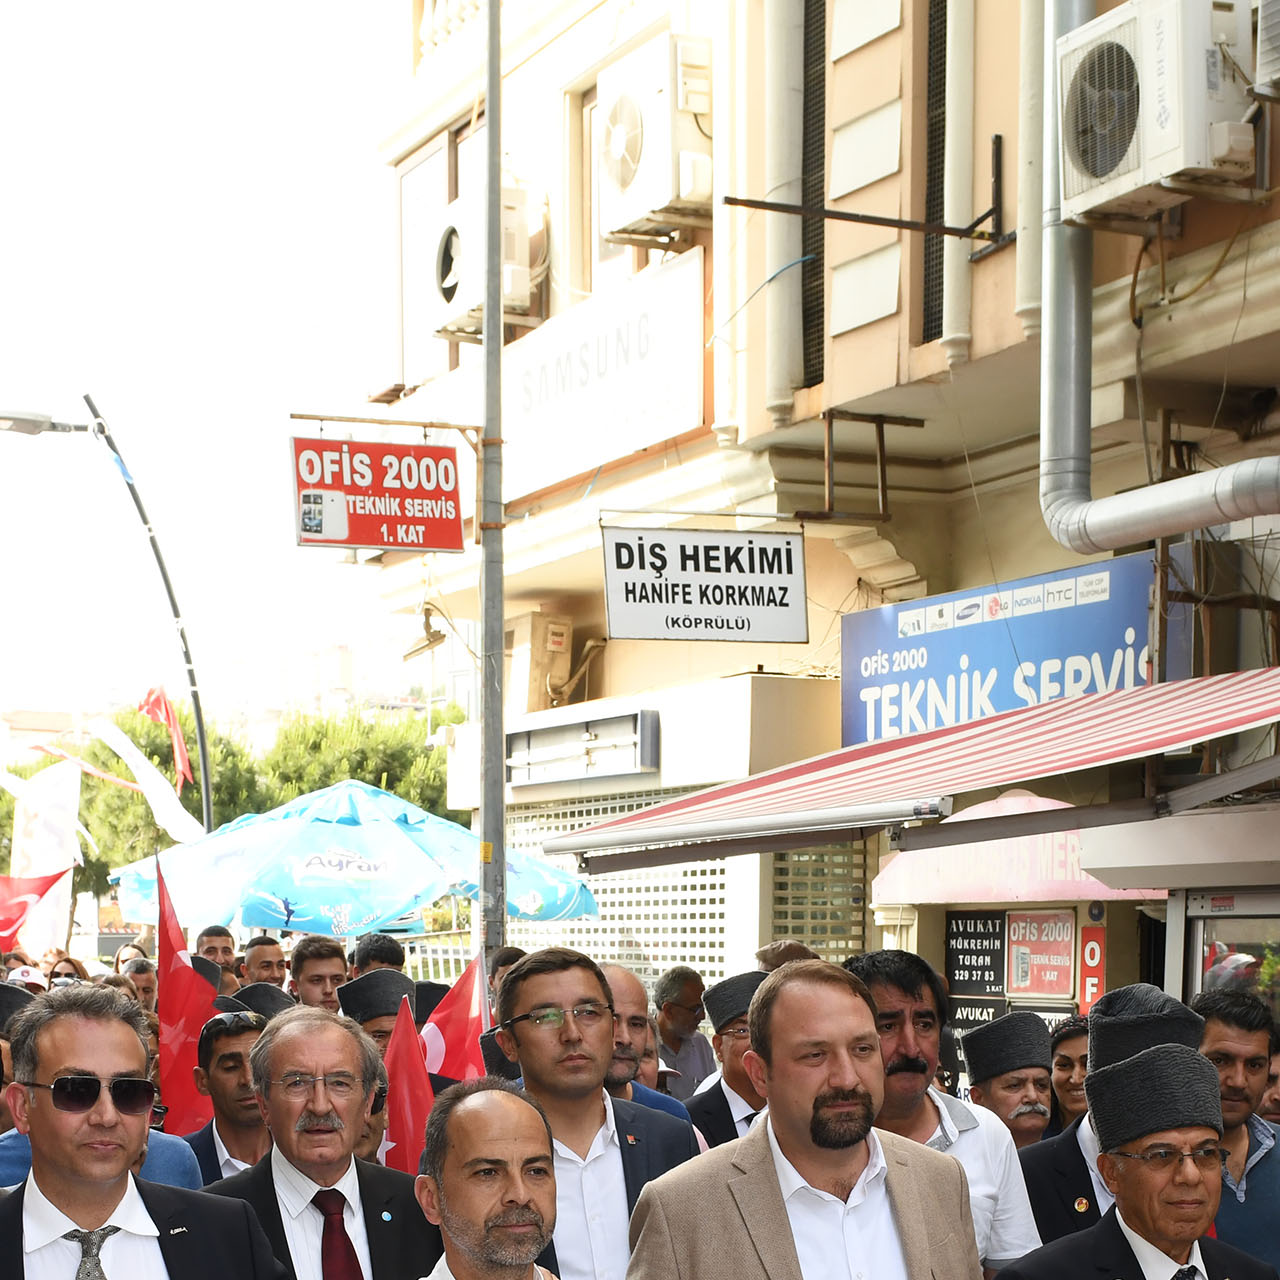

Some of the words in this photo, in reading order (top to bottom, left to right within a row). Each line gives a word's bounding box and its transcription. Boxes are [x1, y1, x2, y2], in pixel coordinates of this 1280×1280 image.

[522, 311, 651, 413] SAMSUNG
[298, 444, 373, 487] OFİS
[381, 454, 456, 492] 2000
[345, 492, 402, 517] TEKNİK
[404, 495, 457, 520] SERVİS
[380, 523, 394, 543] 1.
[396, 524, 426, 544] KAT
[614, 536, 668, 579] DİŞ
[679, 540, 794, 575] HEKİMİ
[624, 577, 693, 605] HANİFE
[698, 584, 790, 608] KORKMAZ
[1014, 594, 1041, 609] NOKIA
[665, 614, 751, 632] (KÖPRÜLÜ)
[860, 648, 889, 678] OFİS
[892, 647, 928, 671] 2000
[860, 654, 998, 742] TEKNİK
[949, 919, 1001, 933] AVUKAT
[1009, 919, 1038, 942] OFİS
[1041, 922, 1071, 942] 2000
[949, 936, 1001, 950] MÜKREMİN
[958, 954, 991, 967] TURAN
[1030, 952, 1049, 965] TEKNİK
[1049, 953, 1070, 967] SERVİS
[954, 970, 969, 981] 329
[971, 970, 982, 981] 37
[984, 971, 995, 982] 83
[991, 985, 1003, 993] KAT
[955, 1007, 995, 1021] AVUKAT
